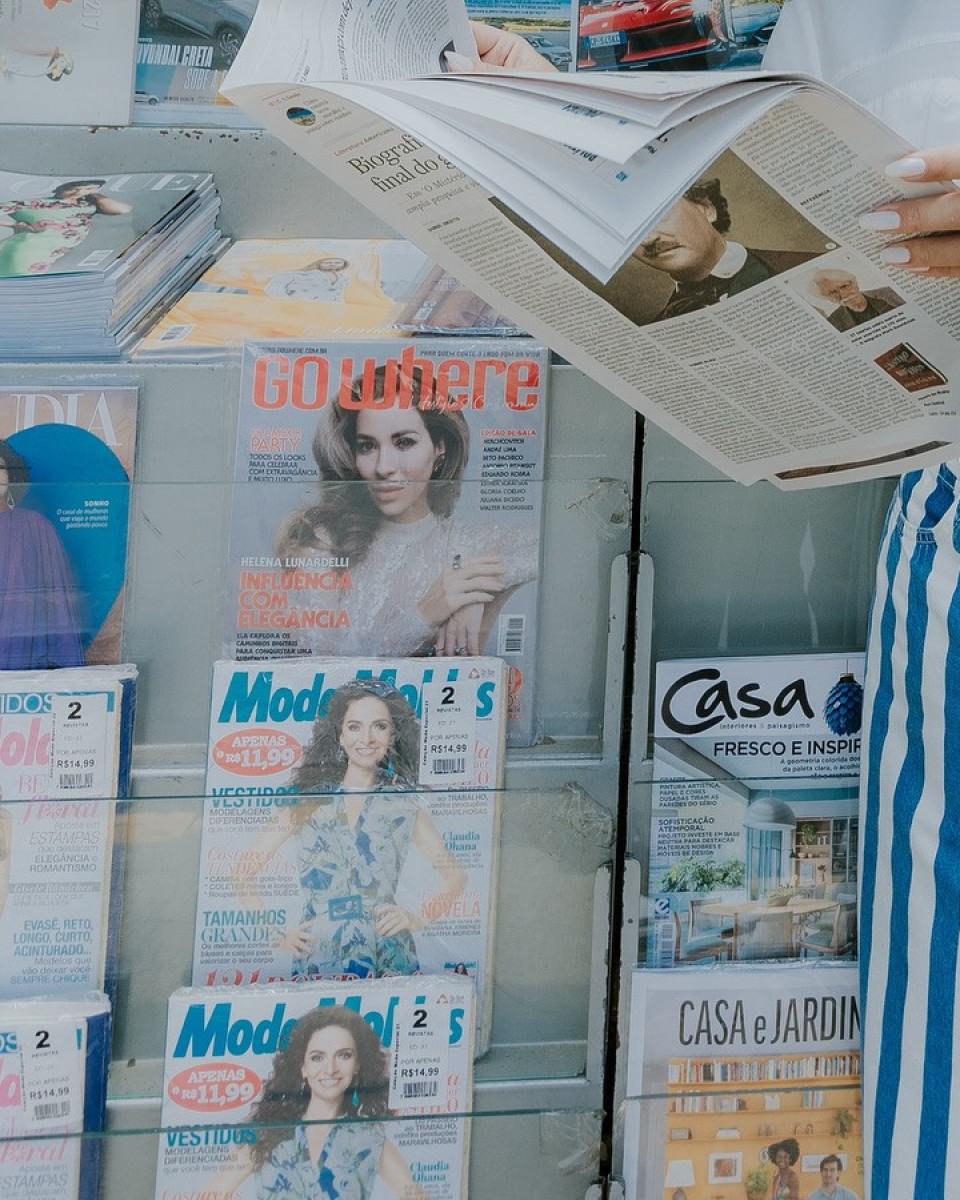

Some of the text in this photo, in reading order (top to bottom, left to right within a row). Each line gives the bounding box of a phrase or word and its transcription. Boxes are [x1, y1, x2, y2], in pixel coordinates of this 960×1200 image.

[181, 45, 214, 68] CRETA
[371, 157, 439, 193] final do
[431, 186, 463, 205] pesquisa
[252, 345, 540, 413] GO where
[251, 437, 301, 452] PARTY
[241, 556, 349, 567] HELENA LUNARDELLI
[240, 567, 353, 591] INFLUÊNCIA
[238, 590, 288, 610] COM
[237, 605, 351, 629] ELEGÂNCIA
[441, 686, 455, 705] 2
[661, 668, 815, 735] Casa
[67, 702, 82, 720] 2
[767, 722, 810, 731] paisagismo
[232, 735, 287, 748] APENAS
[714, 741, 786, 758] FRESCO
[792, 740, 802, 755] E
[786, 758, 820, 766] geometria
[212, 786, 299, 808] VESTIDOS
[658, 817, 714, 826] SOFISTICAÇÃO
[29, 832, 100, 845] ESTAMPAS
[442, 831, 480, 841] Claudia
[445, 840, 477, 851] Ohana
[35, 853, 89, 863] ELEGÂNCIA
[30, 864, 97, 873] ROMANTISMO
[203, 909, 286, 927] TAMANHOS
[421, 901, 481, 918] NOVELA
[201, 927, 286, 942] GRANDES
[10, 974, 90, 984] SEMPRE CHIQUE
[412, 1009, 428, 1028] 2
[679, 999, 747, 1046] CASA
[754, 1015, 766, 1045] e
[35, 1030, 51, 1049] 2
[188, 1069, 245, 1083] APENAS
[166, 1123, 257, 1147] VESTIDOS
[410, 1160, 449, 1172] Claudia
[412, 1171, 446, 1183] Ohana
